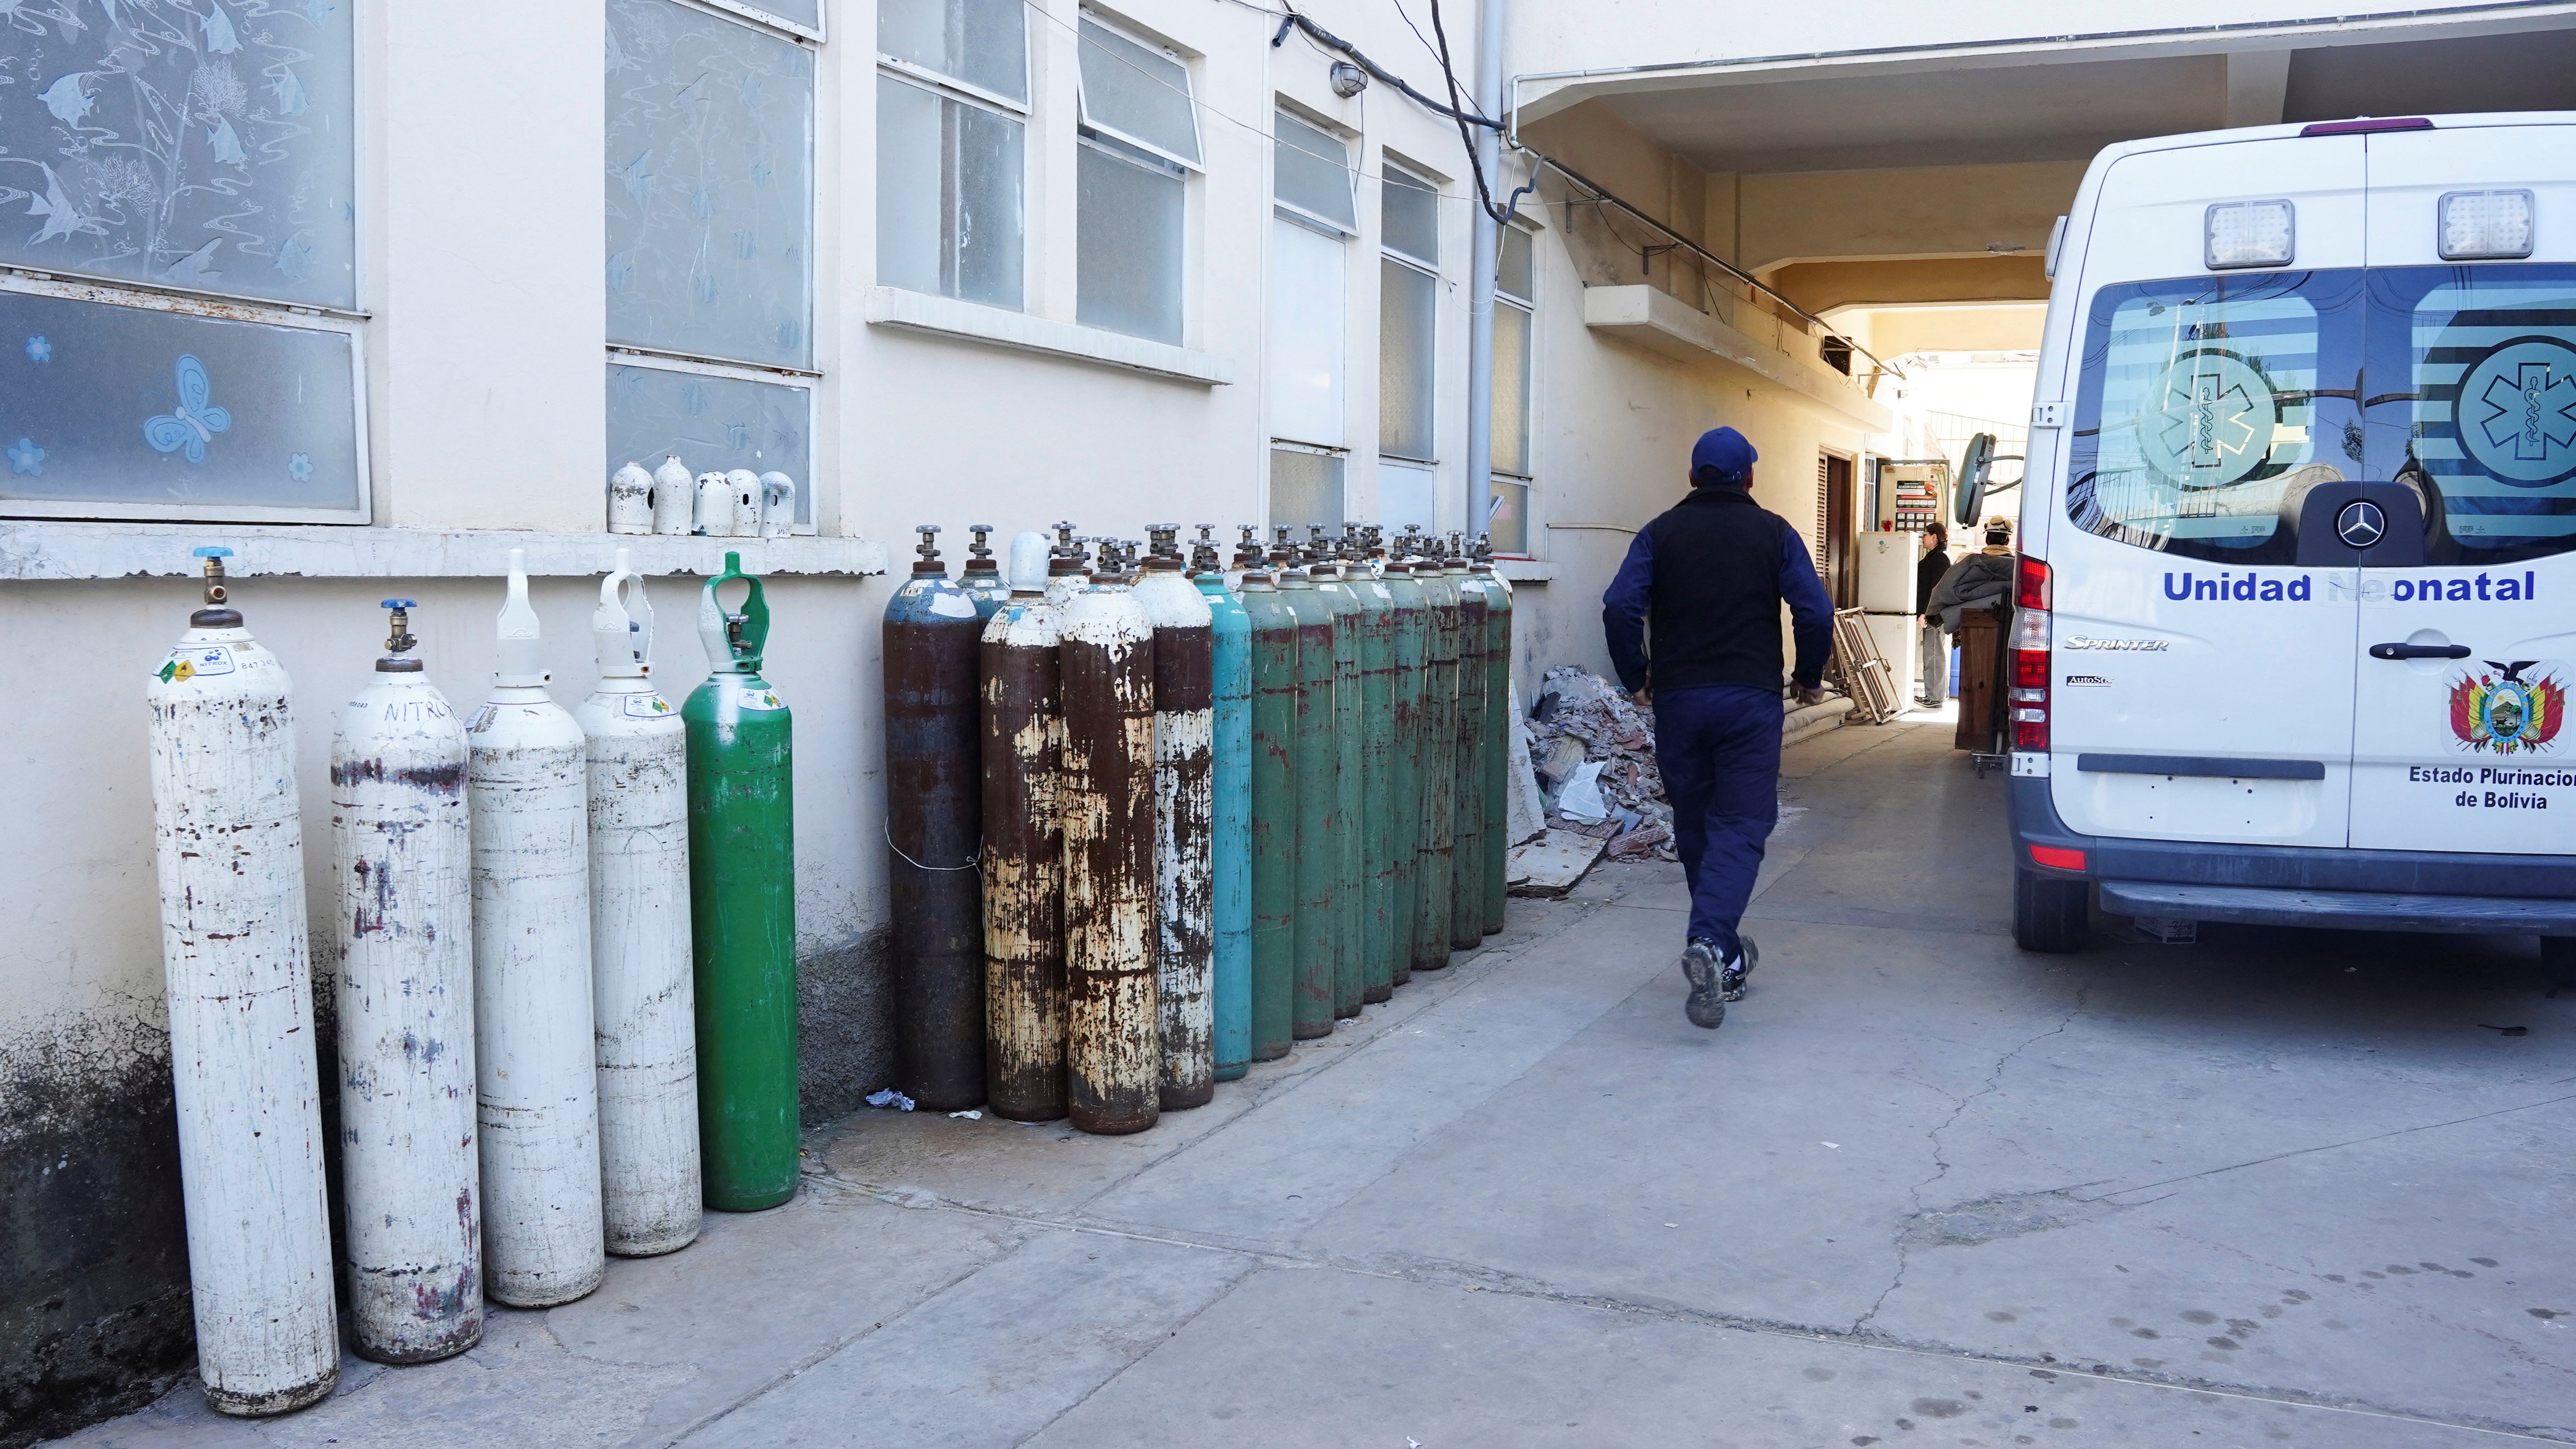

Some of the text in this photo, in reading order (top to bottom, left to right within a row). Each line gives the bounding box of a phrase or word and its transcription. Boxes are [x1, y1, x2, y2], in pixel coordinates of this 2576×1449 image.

[2164, 572, 2311, 601] Unidad
[2064, 635, 2170, 651] SPRINTER
[2409, 766, 2576, 787] Estado Plurinacio
[2455, 791, 2547, 809] de Bolivia
